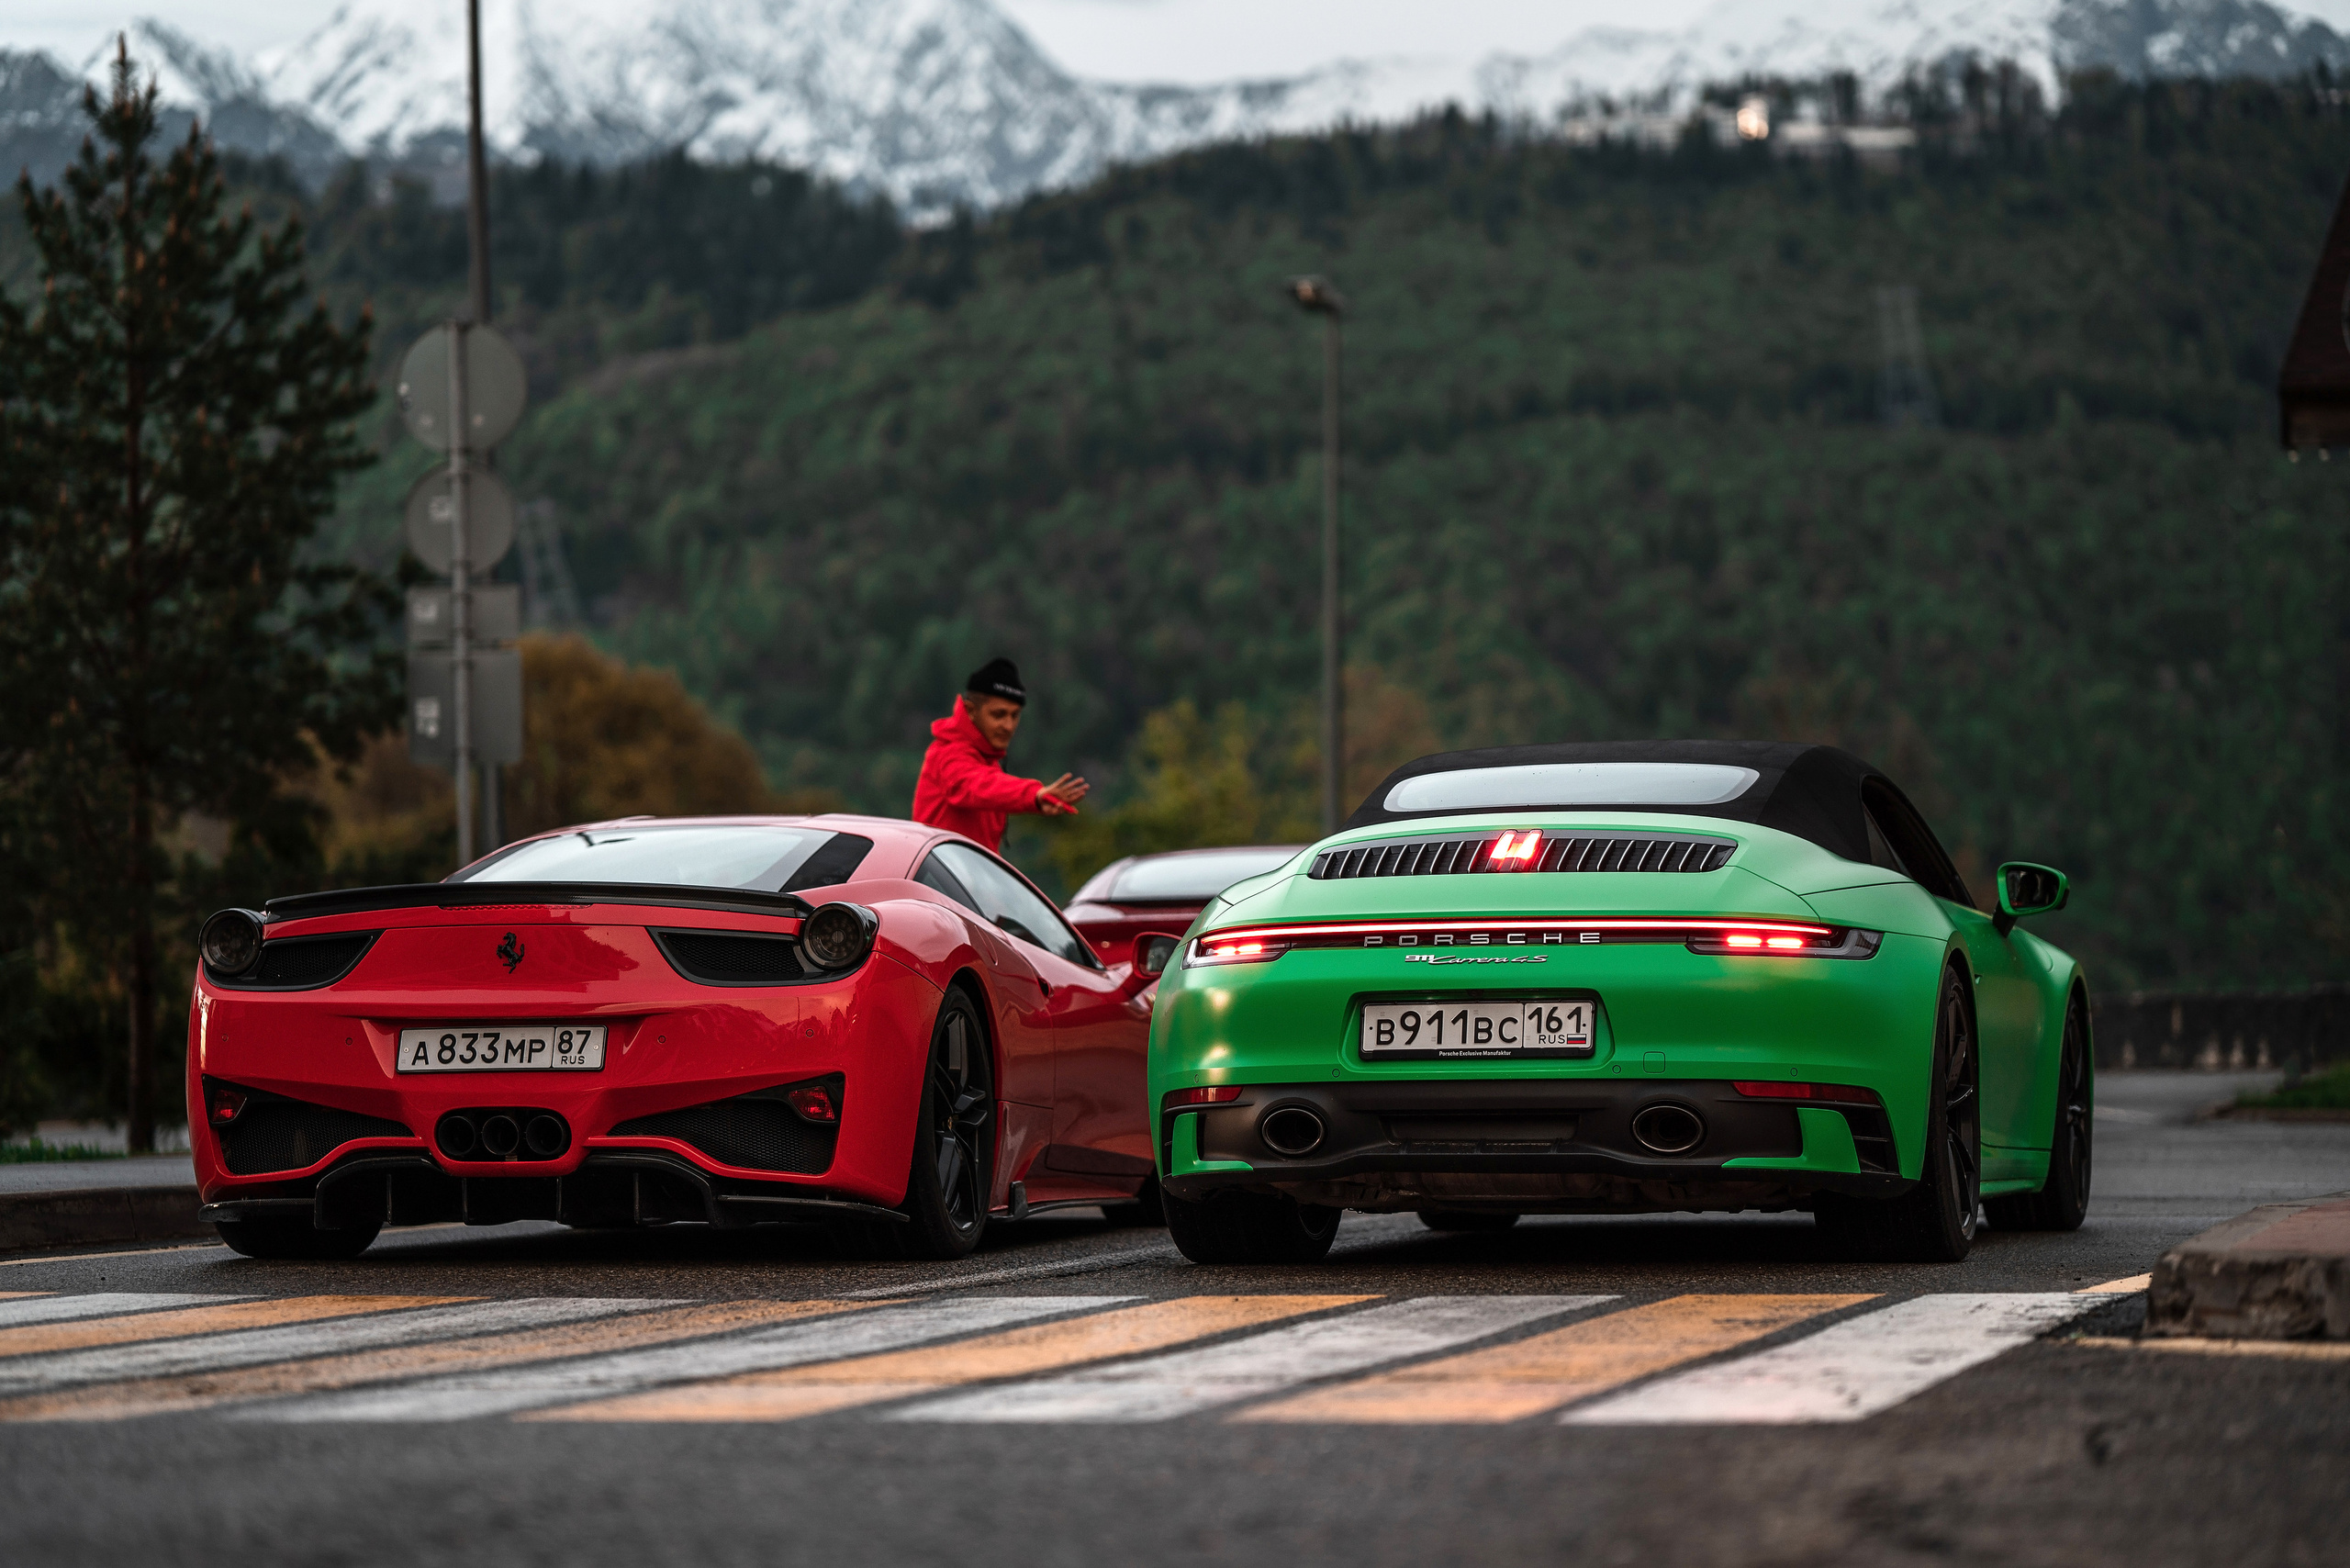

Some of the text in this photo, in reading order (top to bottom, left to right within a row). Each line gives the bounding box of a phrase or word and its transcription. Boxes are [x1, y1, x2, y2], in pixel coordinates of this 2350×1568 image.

[1363, 932, 1601, 947] PORSCHE
[1404, 954, 1549, 965] 911 Carrera 4S
[1528, 1006, 1583, 1034] 161
[557, 1030, 592, 1055] 87
[1539, 1034, 1566, 1045] RUS
[560, 1056, 586, 1065] RUS
